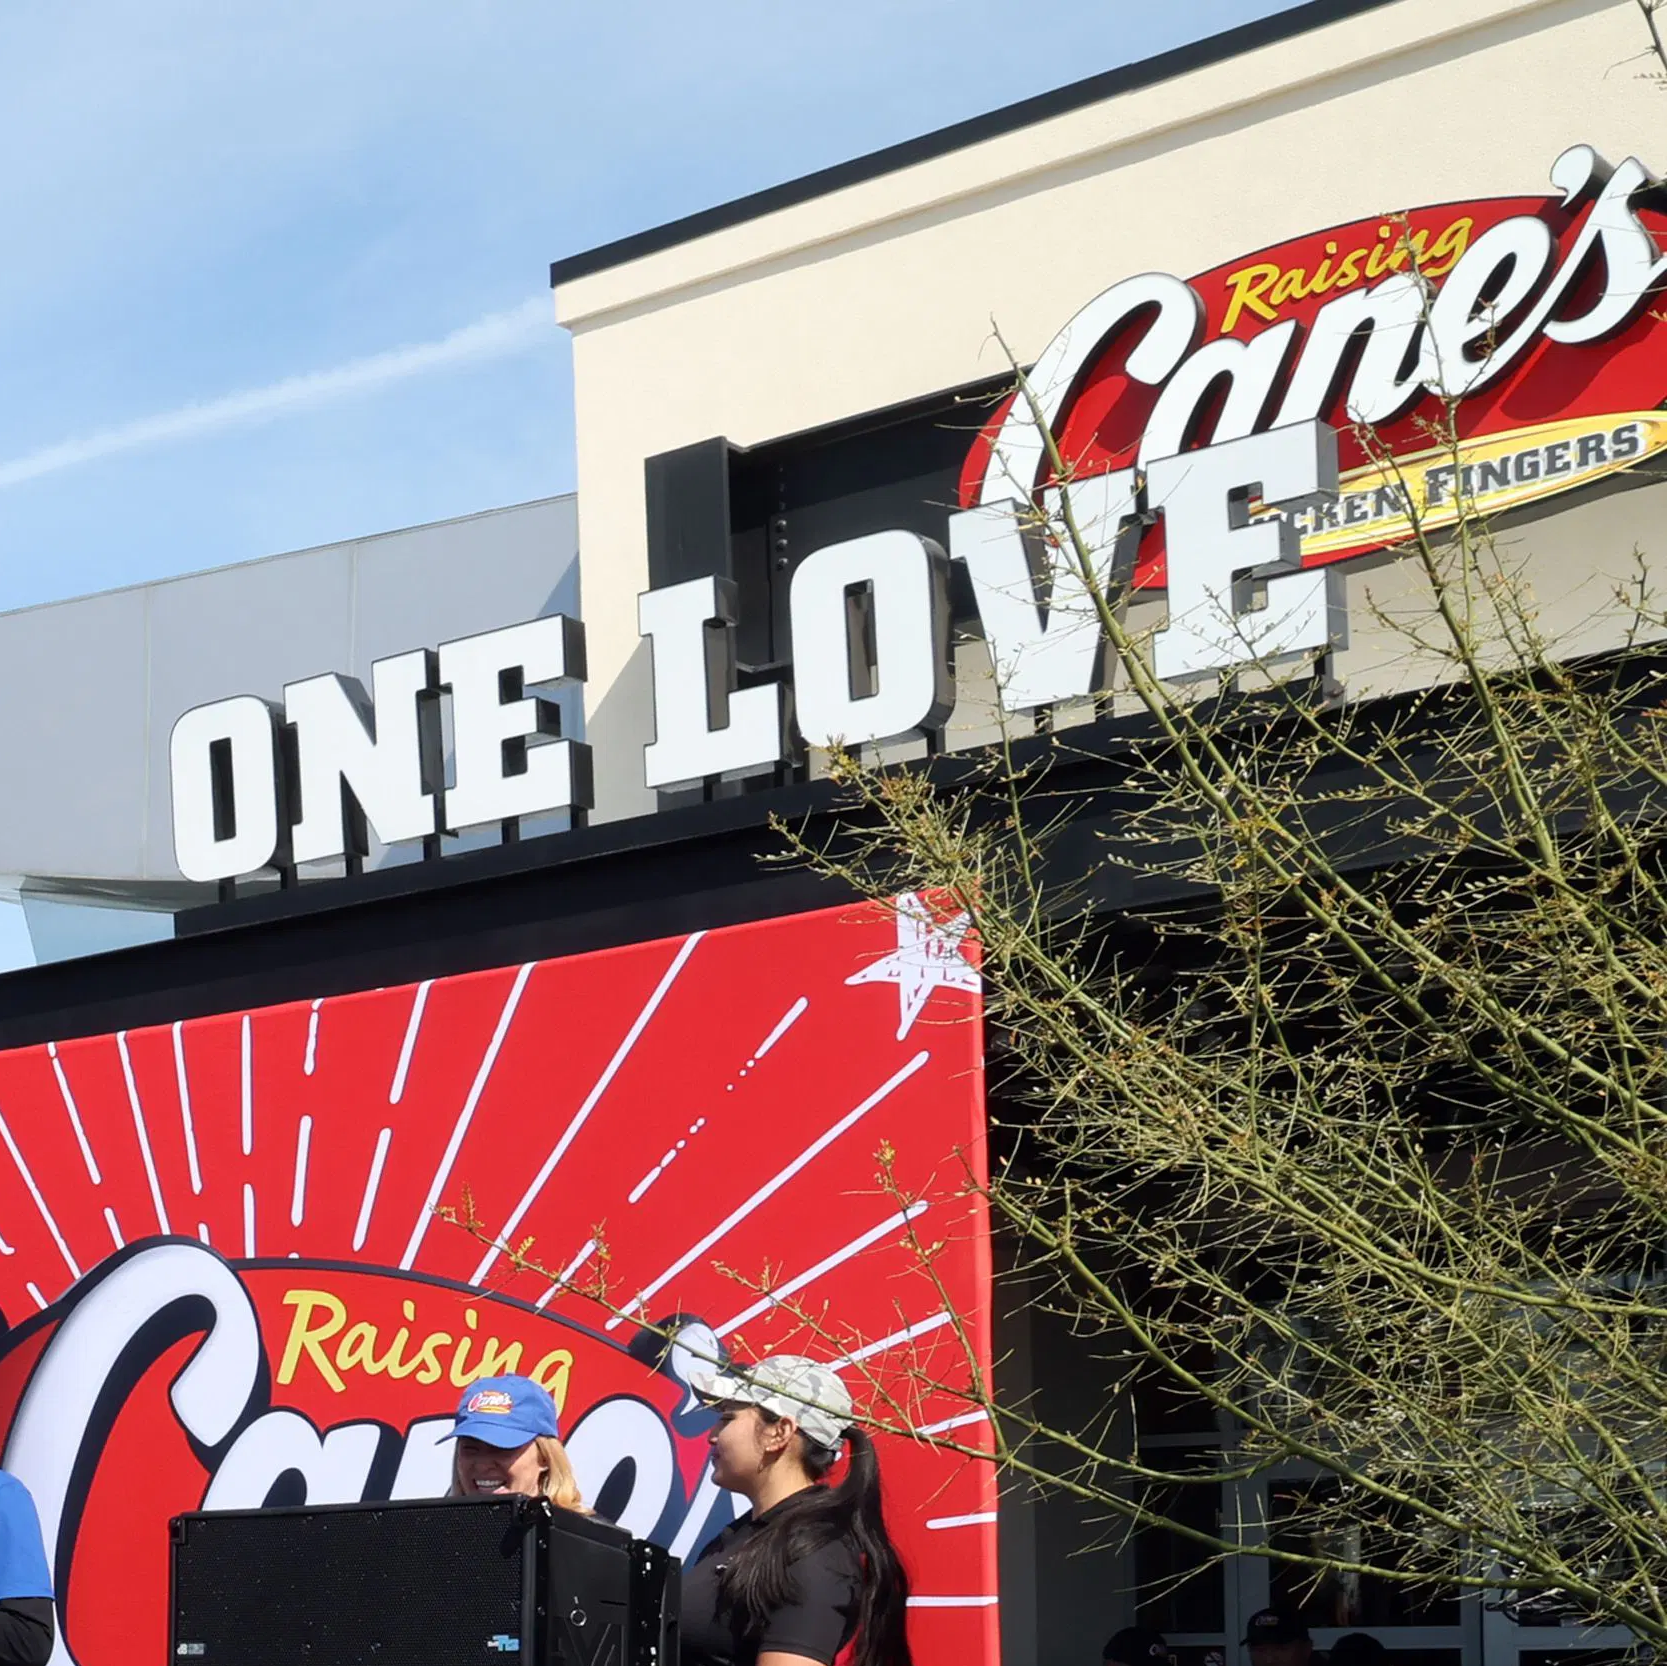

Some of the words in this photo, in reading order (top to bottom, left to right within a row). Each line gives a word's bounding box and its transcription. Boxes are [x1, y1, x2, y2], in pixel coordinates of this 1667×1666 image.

[1220, 216, 1474, 333] Raising
[1425, 423, 1641, 505] FINGERS
[169, 613, 589, 884] ONE
[638, 420, 1345, 790] LOVE
[277, 1290, 574, 1418] Raising
[468, 1391, 513, 1413] Cane's
